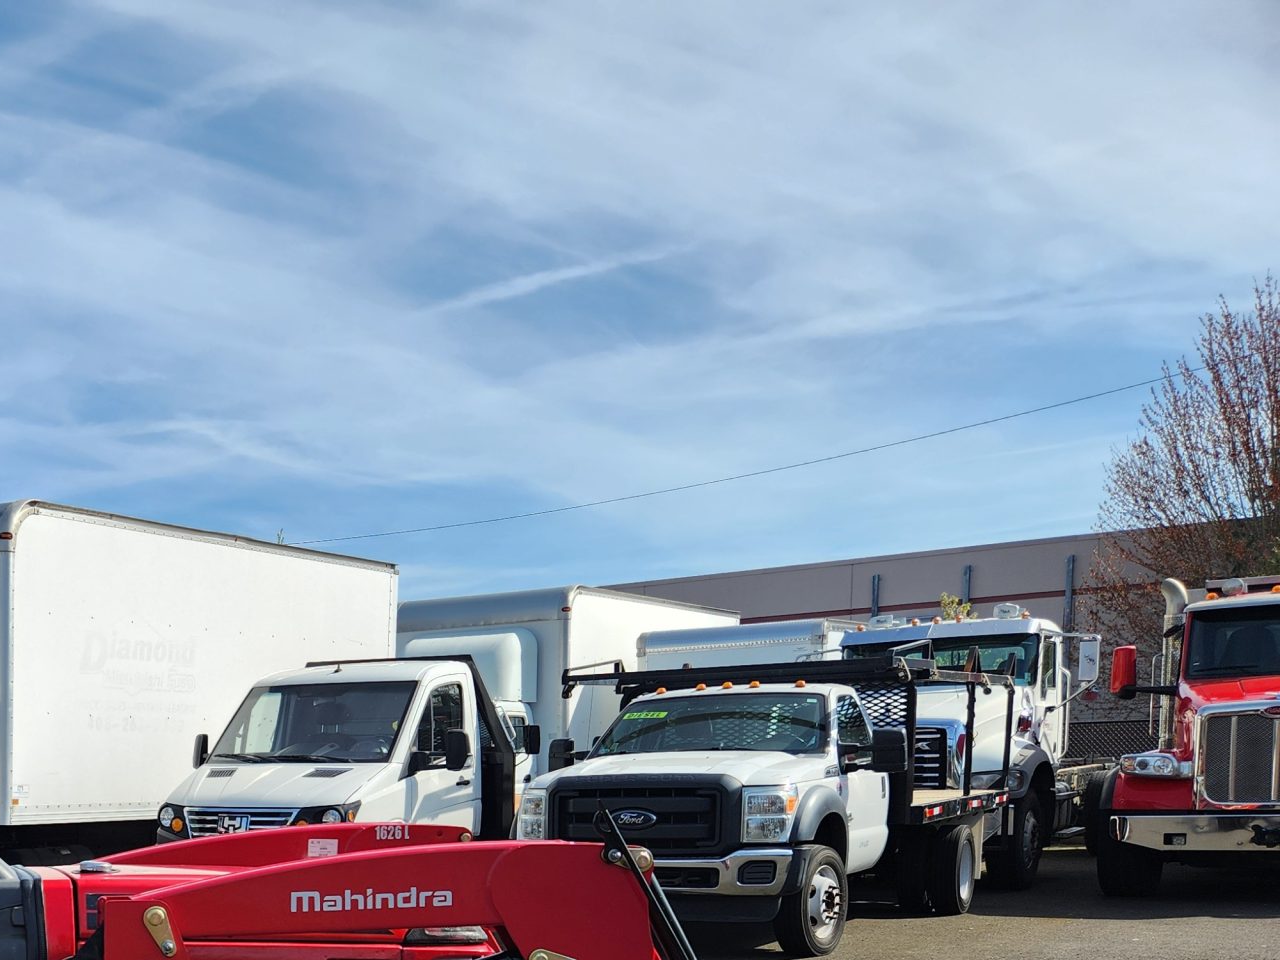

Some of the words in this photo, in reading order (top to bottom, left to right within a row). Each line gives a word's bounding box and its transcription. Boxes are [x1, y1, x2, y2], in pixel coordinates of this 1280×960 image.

[618, 812, 645, 824] Ford
[375, 825, 402, 840] 1626
[404, 825, 410, 840] L
[290, 887, 453, 912] Mahindra
